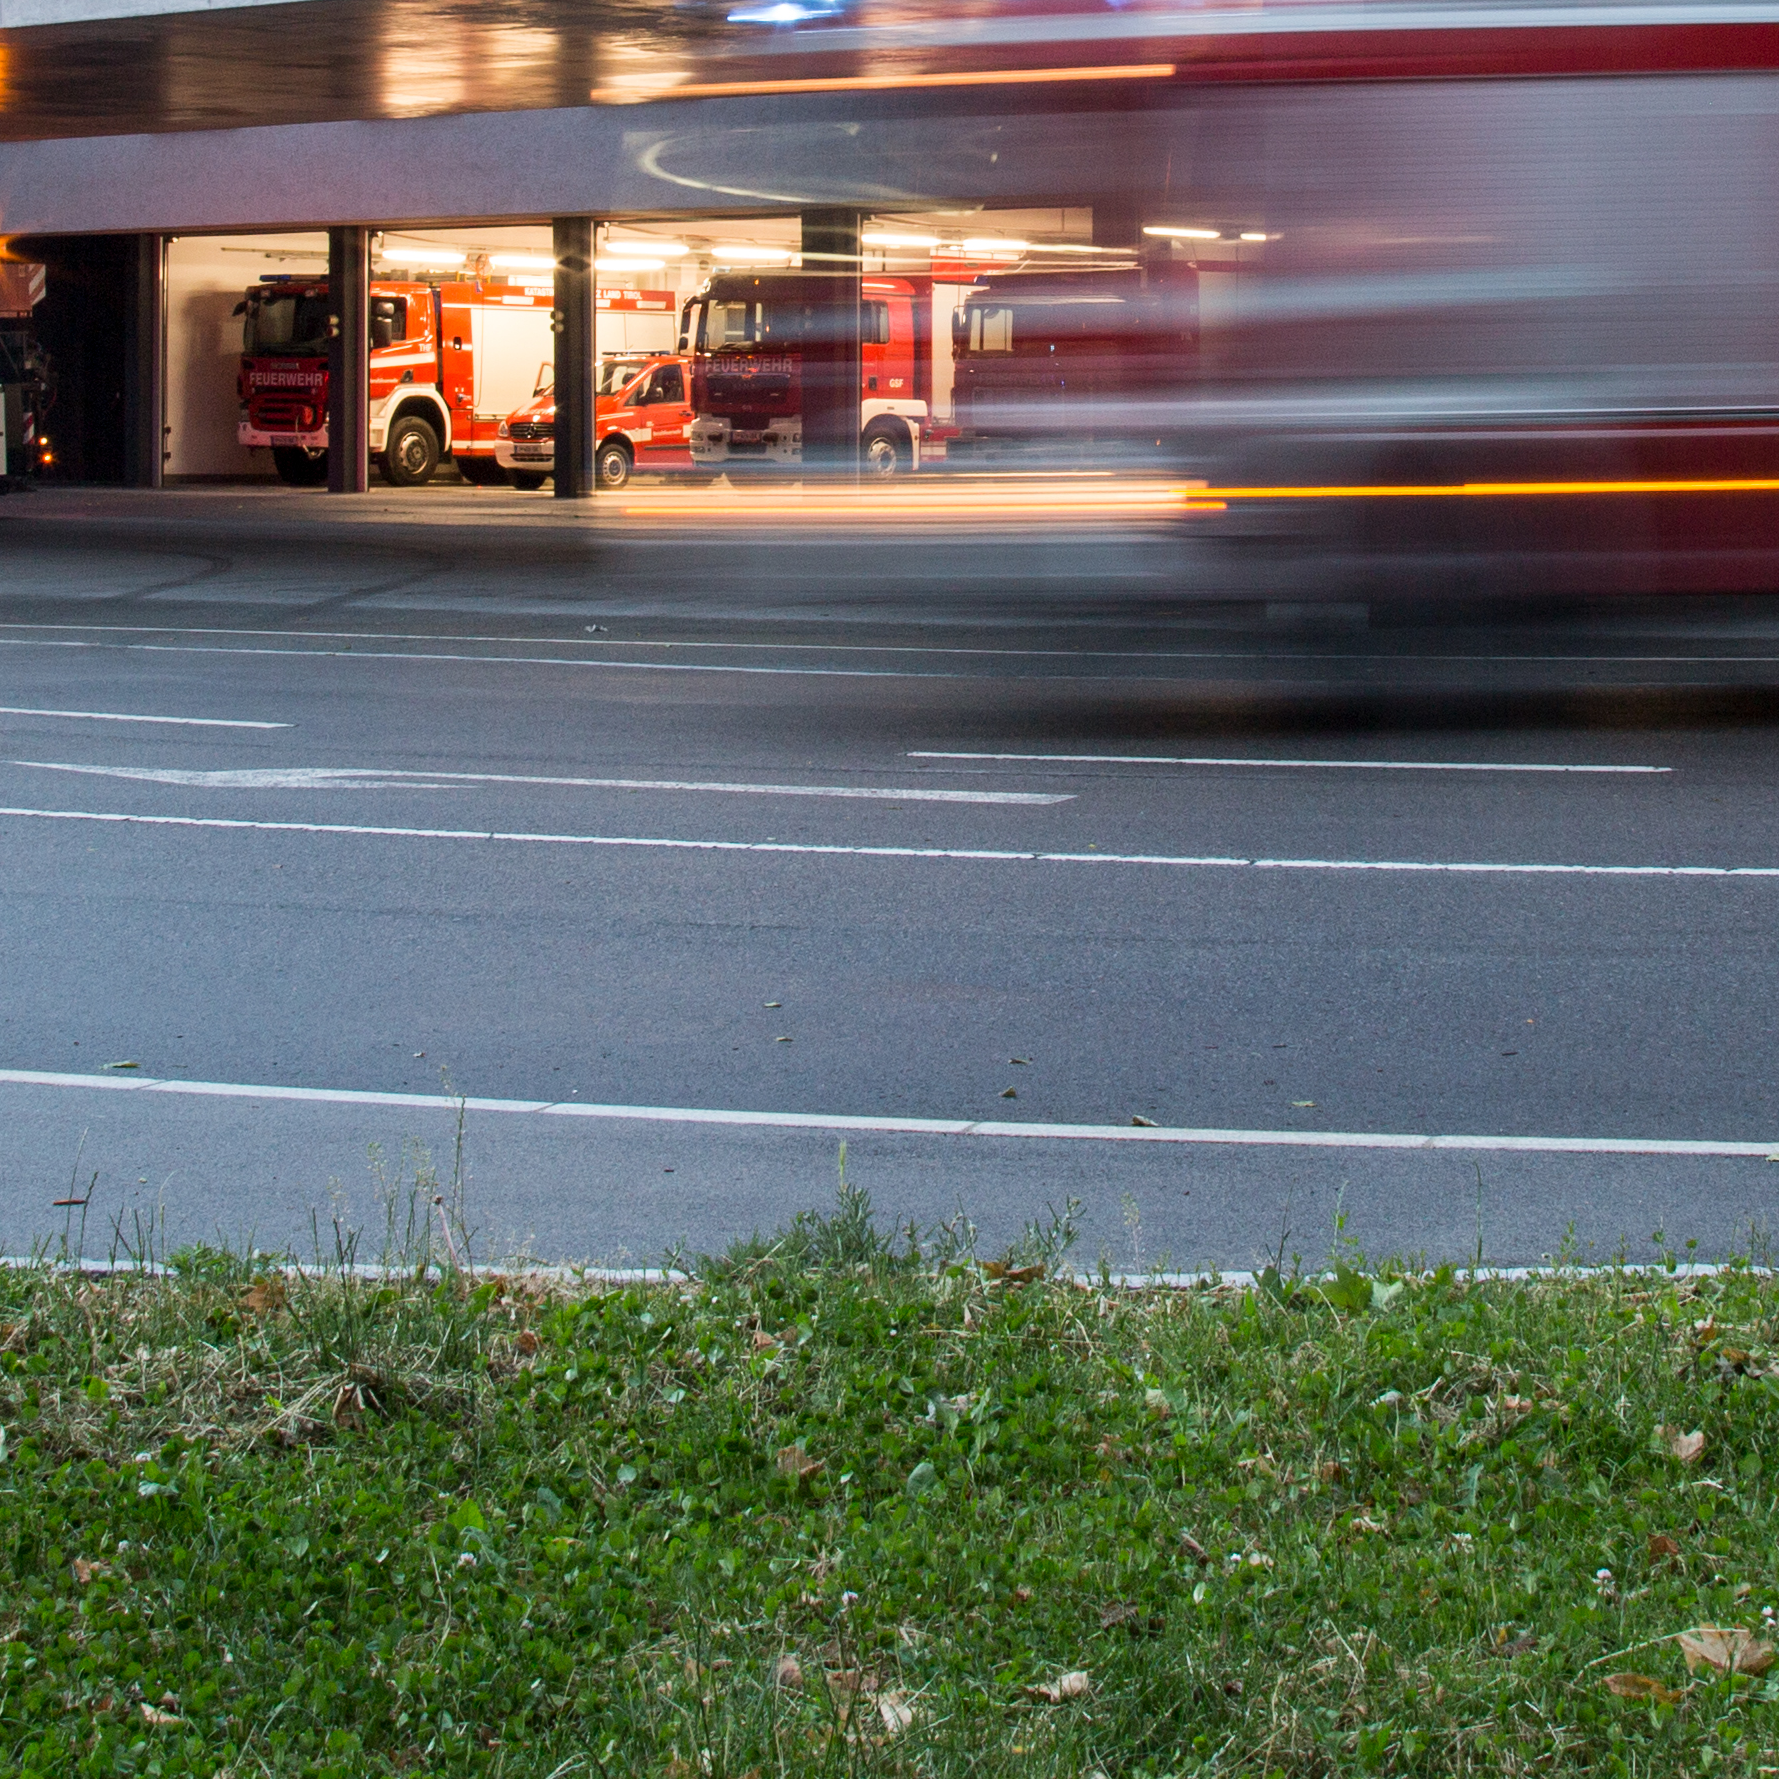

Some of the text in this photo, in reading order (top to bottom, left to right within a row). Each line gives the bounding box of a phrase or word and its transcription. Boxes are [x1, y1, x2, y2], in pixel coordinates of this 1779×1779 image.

[603, 290, 621, 299] LAND
[623, 291, 642, 300] TIROL
[705, 358, 793, 372] FEUERWEHR
[249, 372, 323, 386] FEUERWEHR
